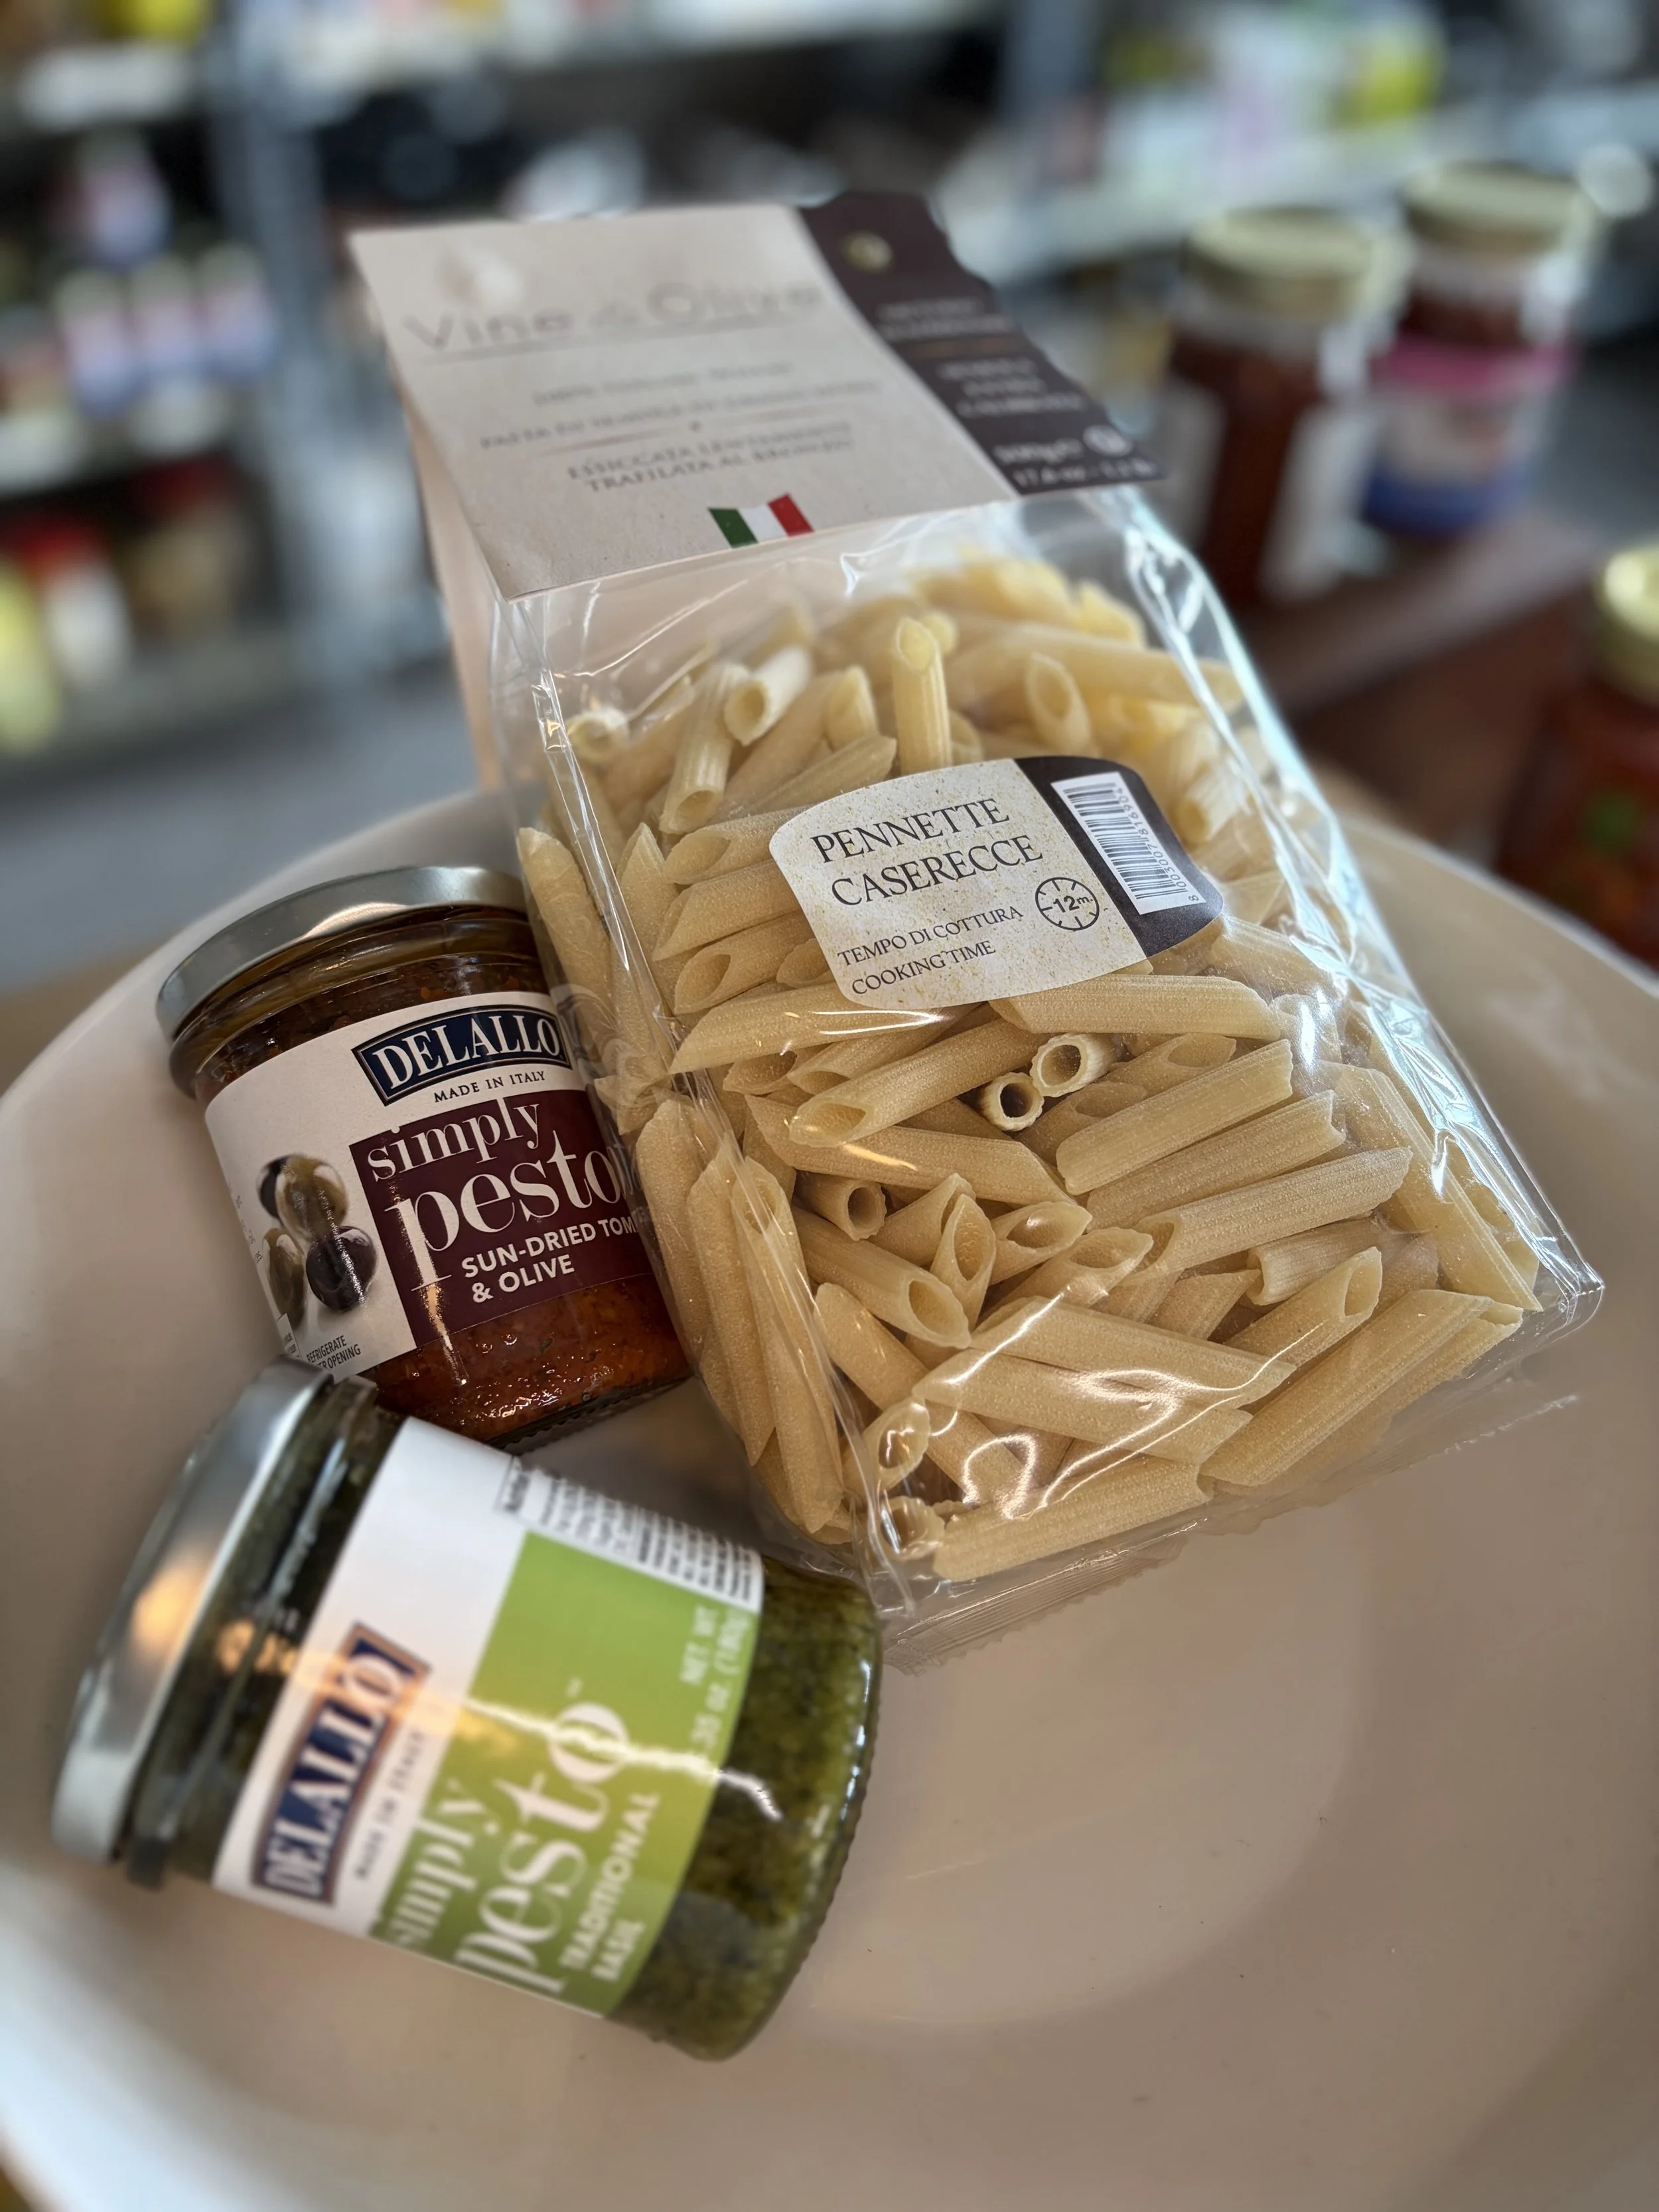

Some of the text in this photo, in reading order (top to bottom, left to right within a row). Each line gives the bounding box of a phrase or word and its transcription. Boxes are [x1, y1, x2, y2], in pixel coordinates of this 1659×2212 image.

[401, 309, 575, 352] Vine
[810, 798, 1009, 863] PENNETTE
[831, 835, 1043, 905] CASERECCE
[837, 905, 1024, 966] TEMPO DI COTTURA
[851, 940, 996, 994] COOKING TIME
[371, 1015, 561, 1090] DELALLO
[433, 1070, 547, 1104] MADE IN ITALY
[367, 1098, 540, 1183] simply
[384, 1130, 621, 1291] pesto
[461, 1216, 637, 1278] SUN-DRIED TOM
[470, 1254, 576, 1304] & OLIVE
[307, 1335, 347, 1363] REFRIGERATE
[327, 1344, 362, 1369] OPENING
[265, 1655, 403, 1897] DELALLO
[381, 1777, 500, 1947] simply
[453, 1701, 630, 1993] pesto
[557, 1792, 658, 1970] TRADITIONAL
[591, 1921, 646, 1983] BASIL
